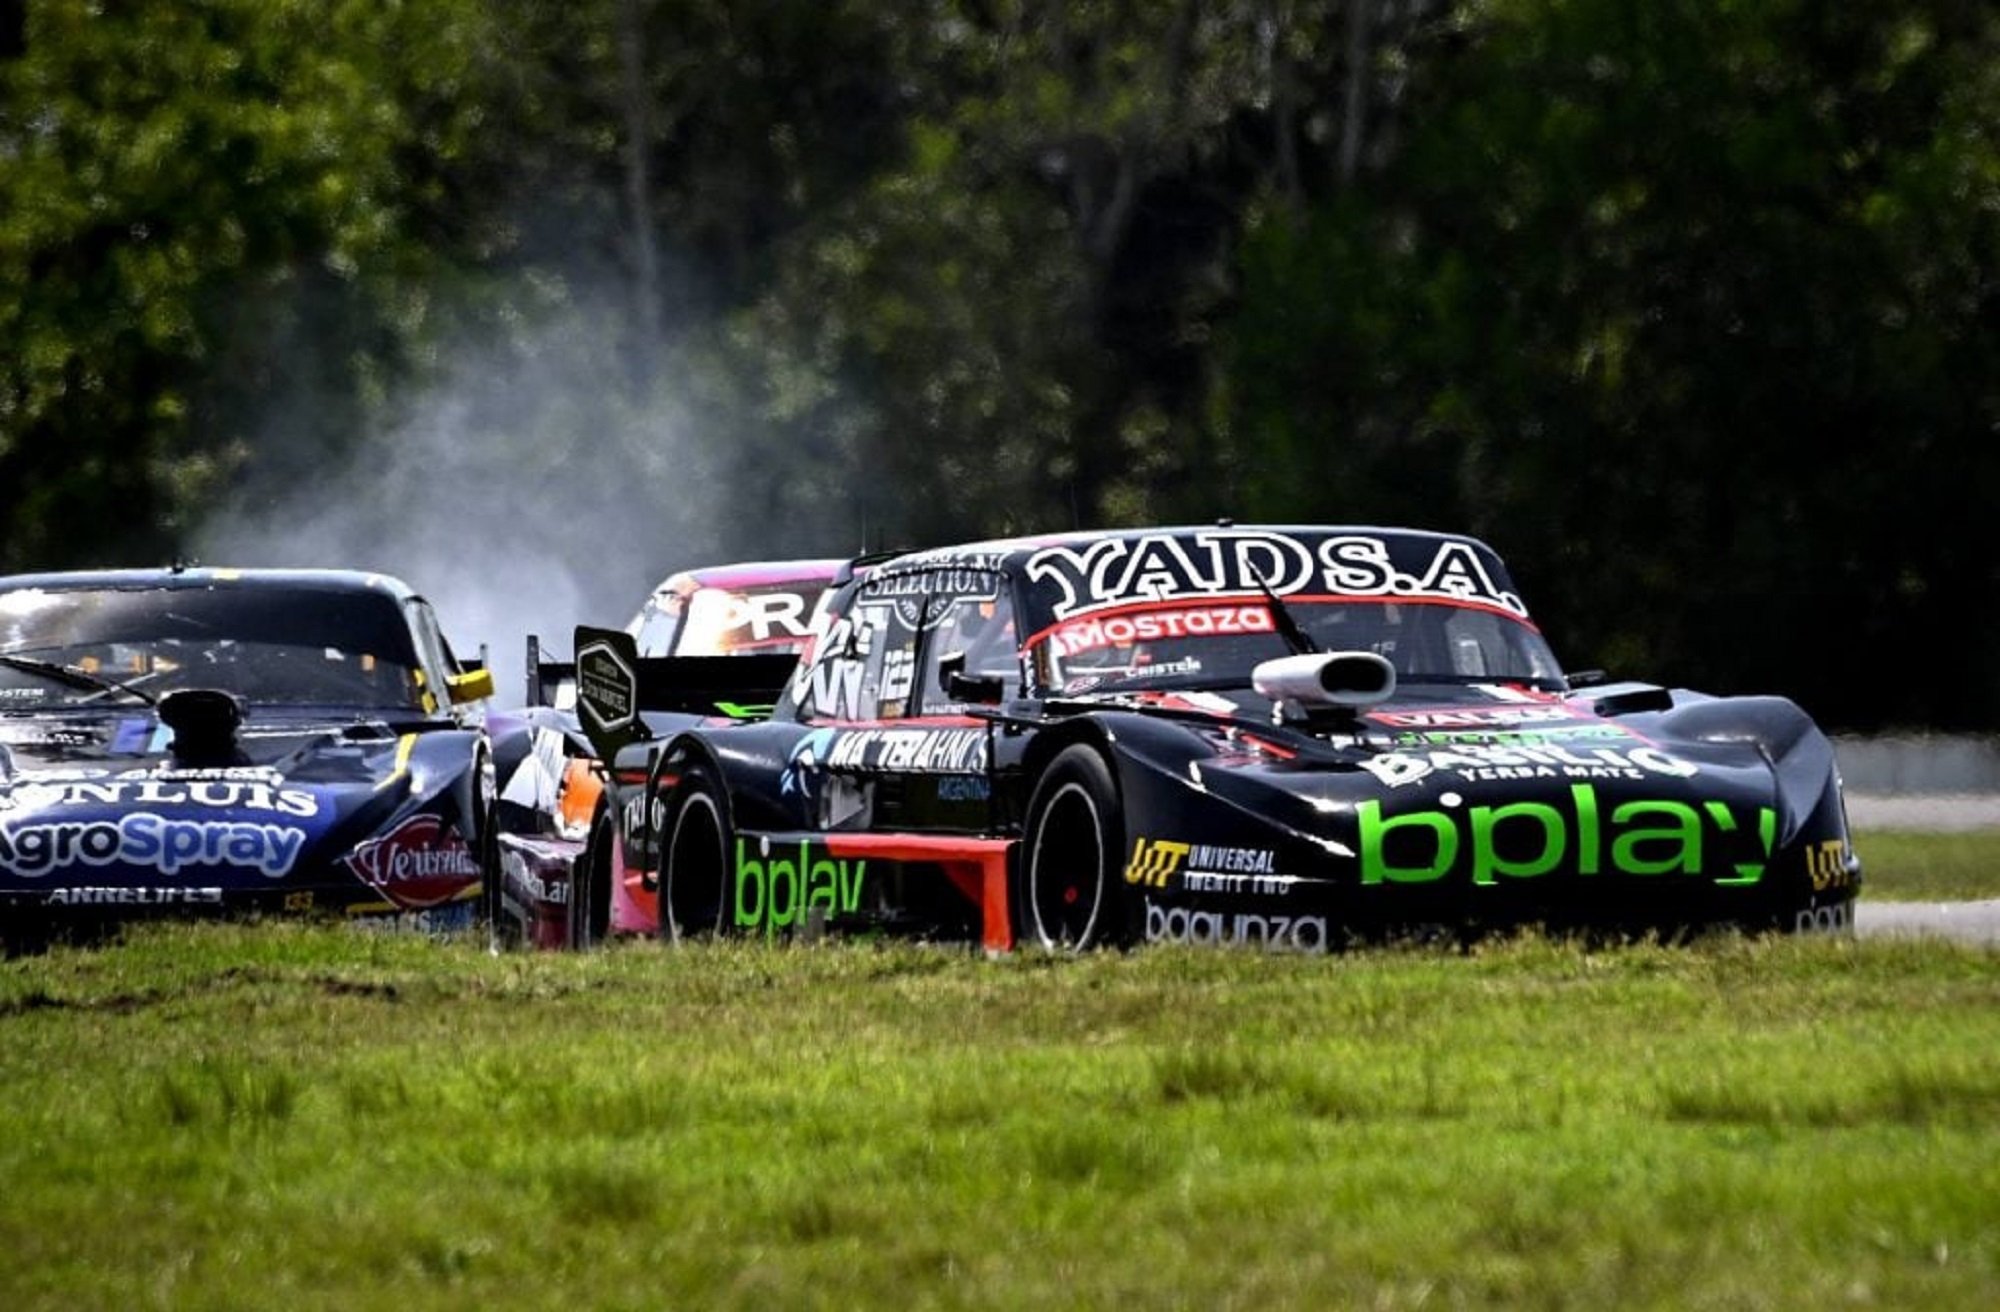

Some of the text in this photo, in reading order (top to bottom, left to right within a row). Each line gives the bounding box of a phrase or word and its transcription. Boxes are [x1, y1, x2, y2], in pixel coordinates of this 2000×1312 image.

[1357, 746, 1699, 788] BASILIO
[1457, 765, 1645, 782] YERBA MATE
[1355, 784, 1776, 886] bplay
[1124, 836, 1190, 888] UTT
[1187, 845, 1275, 873] UNIVERSAL
[1183, 870, 1291, 895] TWENTY TWO
